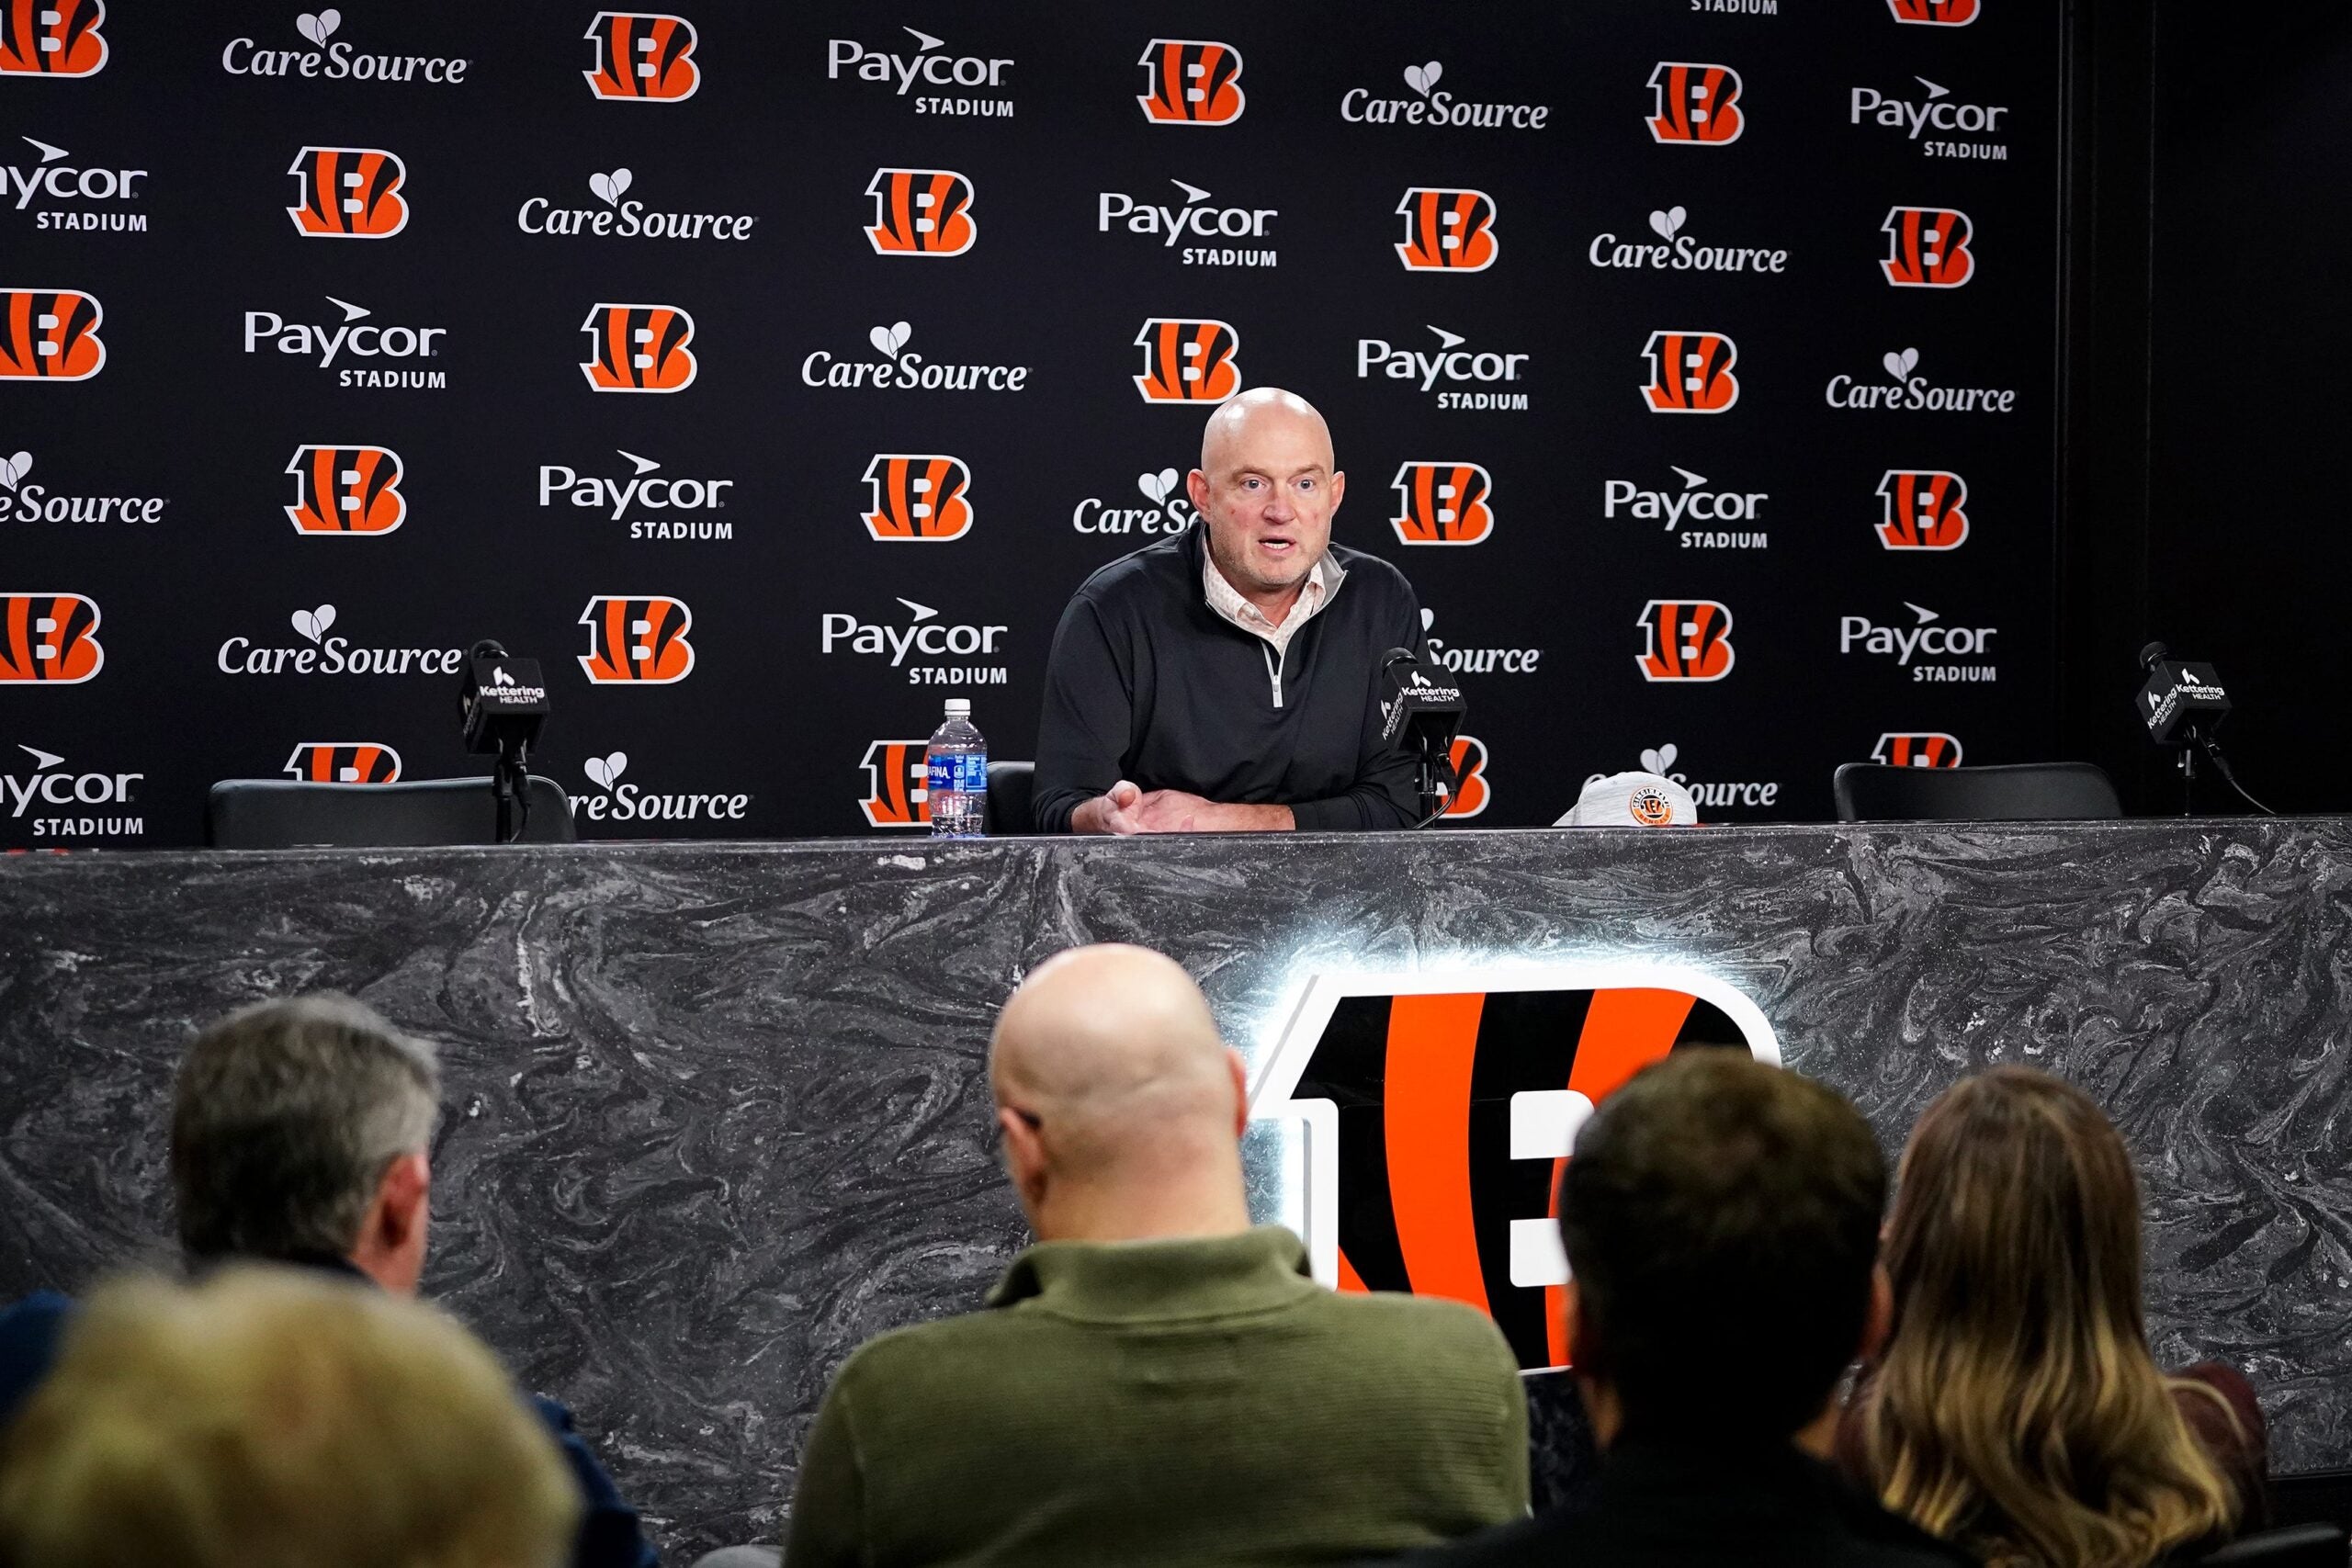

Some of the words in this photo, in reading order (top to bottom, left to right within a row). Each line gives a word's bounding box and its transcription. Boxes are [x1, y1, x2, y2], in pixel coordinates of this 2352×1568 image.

[1691, 0, 1778, 15] STADIUM
[223, 39, 467, 83] CareSource
[582, 12, 700, 102] B
[829, 39, 1014, 95] Paycor
[1136, 39, 1245, 126] B
[1645, 62, 1744, 145] B
[916, 97, 1013, 117] STADIUM
[1341, 88, 1548, 129] CareSource
[1852, 88, 2007, 139] Paycor
[1925, 141, 2007, 159] STADIUM
[0, 166, 147, 209] ycor
[287, 146, 409, 239] B
[38, 212, 146, 231] STADIUM
[518, 197, 752, 240] CareSource
[864, 168, 977, 256] B
[1100, 193, 1278, 246] Paycor
[1395, 187, 1498, 272] B
[1183, 248, 1276, 266] STADIUM
[1589, 234, 1787, 272] CareSource
[1880, 207, 1974, 288] B
[245, 311, 447, 367] Paycor
[580, 303, 697, 393] B
[1132, 318, 1241, 404] B
[340, 370, 446, 389] STADIUM
[802, 351, 1027, 390] CareSource
[1358, 340, 1529, 391] Paycor
[1640, 331, 1739, 413] B
[1438, 393, 1528, 410] STADIUM
[1826, 375, 2015, 412] CareSource
[284, 445, 406, 536] B
[540, 466, 733, 520] Paycor
[860, 454, 973, 541] B
[1390, 461, 1494, 546] B
[1605, 480, 1768, 531] Paycor
[1874, 470, 1969, 550] B
[631, 522, 732, 539] STADIUM
[1073, 499, 1199, 535] CareS
[1681, 532, 1767, 547] STADIUM
[219, 637, 462, 673] CareSource
[577, 595, 695, 684] B
[822, 614, 1008, 666] Paycor
[1427, 638, 1539, 672] Source
[1635, 600, 1735, 682] B
[1841, 617, 1996, 665] Paycor
[480, 686, 545, 698] Kettering
[910, 668, 1007, 684] STADIUM
[1402, 687, 1460, 697] Kettering
[1914, 667, 1996, 681] STADIUM
[2176, 683, 2224, 695] Kettering
[1383, 692, 1403, 740] Kettering
[2147, 687, 2177, 729] Kettering
[2159, 700, 2176, 726] HEALTH
[0, 773, 143, 817] ycor
[569, 784, 748, 820] reSource
[34, 818, 142, 835] STADIUM
